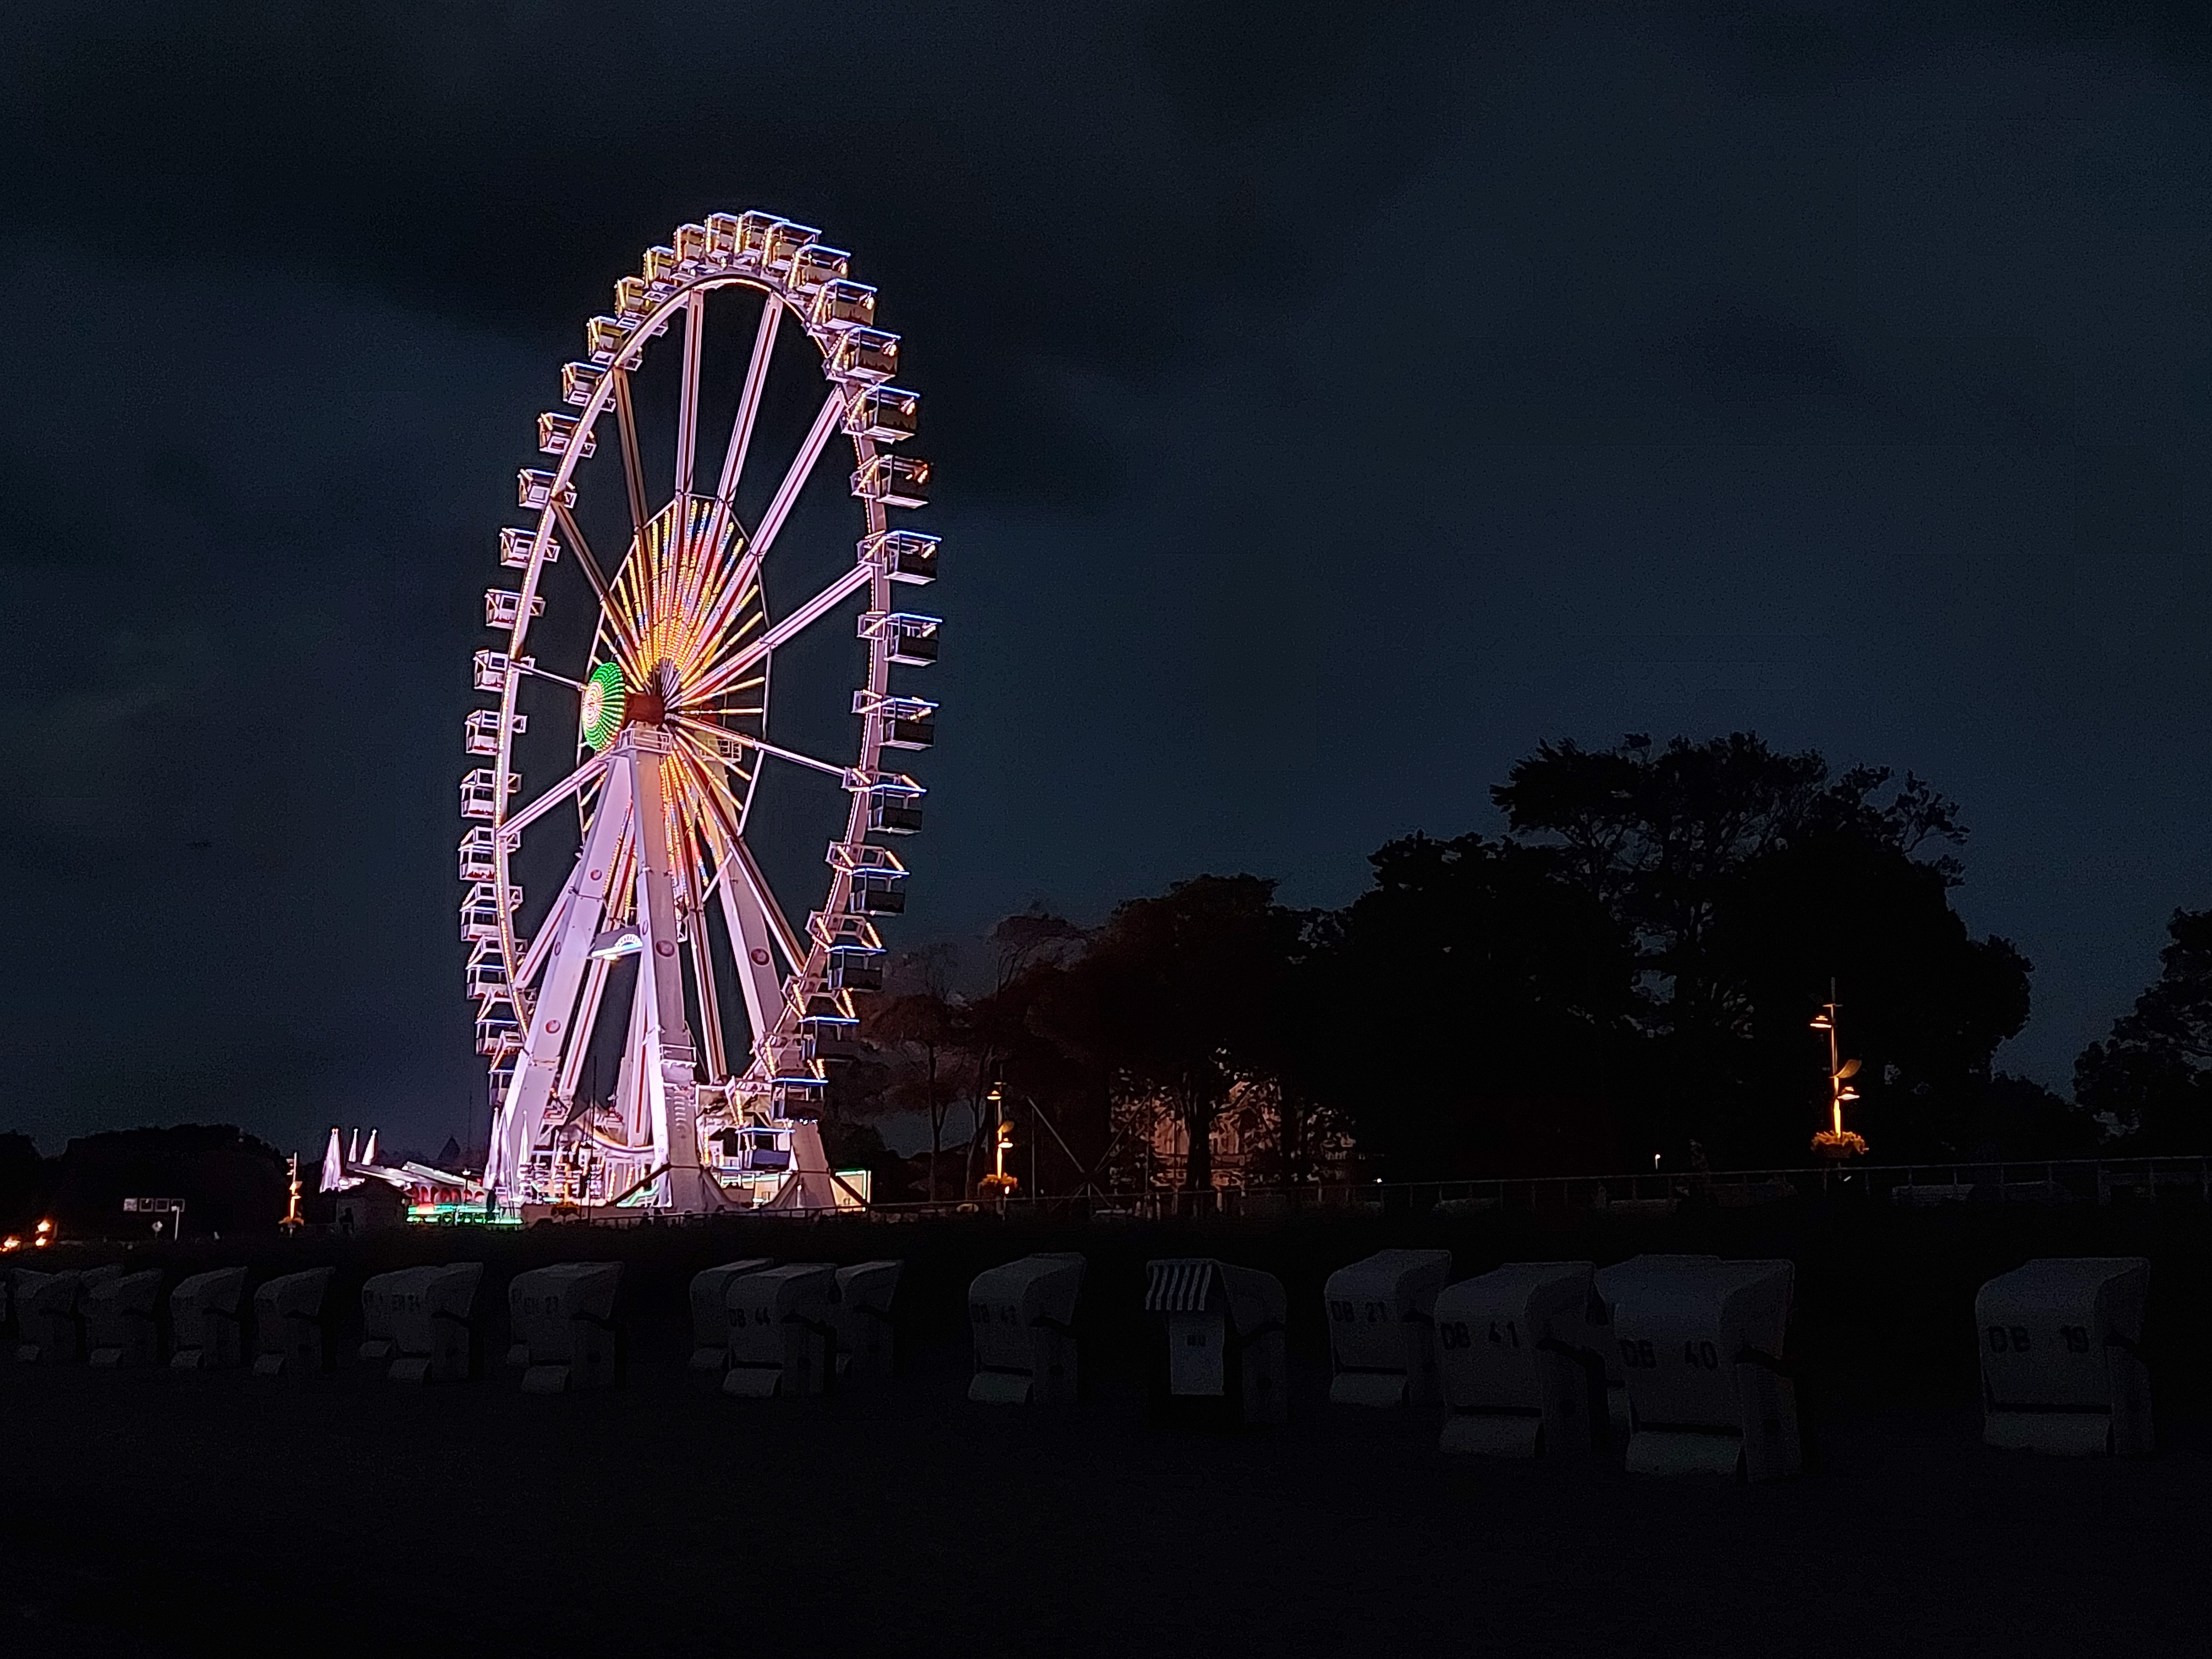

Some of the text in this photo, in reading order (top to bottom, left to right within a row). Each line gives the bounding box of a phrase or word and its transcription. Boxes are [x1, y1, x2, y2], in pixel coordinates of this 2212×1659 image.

[728, 1307, 771, 1328] DB 44
[1329, 1300, 1387, 1323] DB 21
[1439, 1320, 1519, 1350] DB 41
[1987, 1324, 2090, 1354] DB 19
[1619, 1338, 1719, 1371] DB 40
